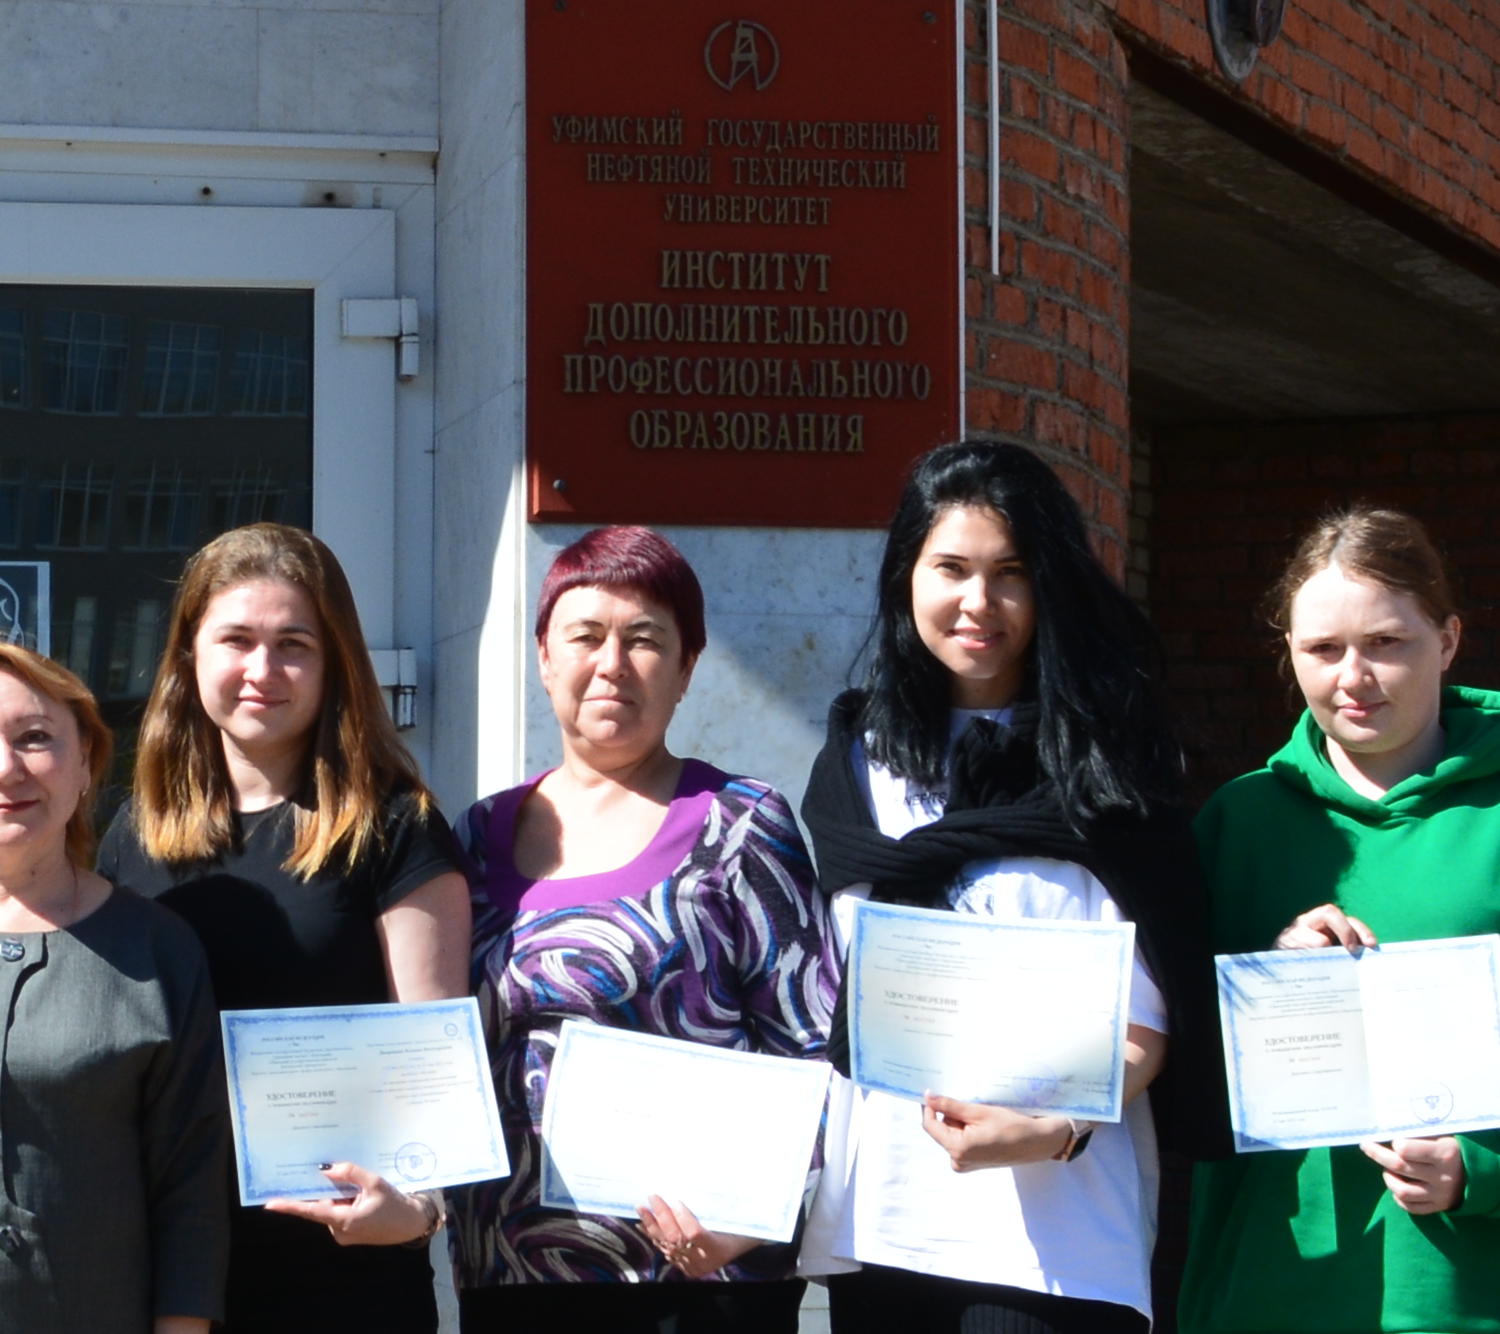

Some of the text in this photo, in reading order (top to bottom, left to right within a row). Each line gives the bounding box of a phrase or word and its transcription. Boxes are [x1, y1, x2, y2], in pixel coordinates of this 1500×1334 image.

[551, 108, 940, 153] УФИМСКИЙ ГОСУДАРСТВЕННЫЙ
[585, 149, 907, 189] НЕФТЯНОЙ ТЕХНИЧЕСКИЙ
[663, 194, 832, 225] УНИВЕРСИТЕТ
[660, 250, 832, 293] ИНСТИТУТ
[583, 302, 908, 348] ДОПОЛНИТЕЛЬНОГО
[562, 354, 931, 400] ПРОФЕССИОНАЛЬНОГО
[630, 410, 865, 453] ОБРАЗОВАНИЯ
